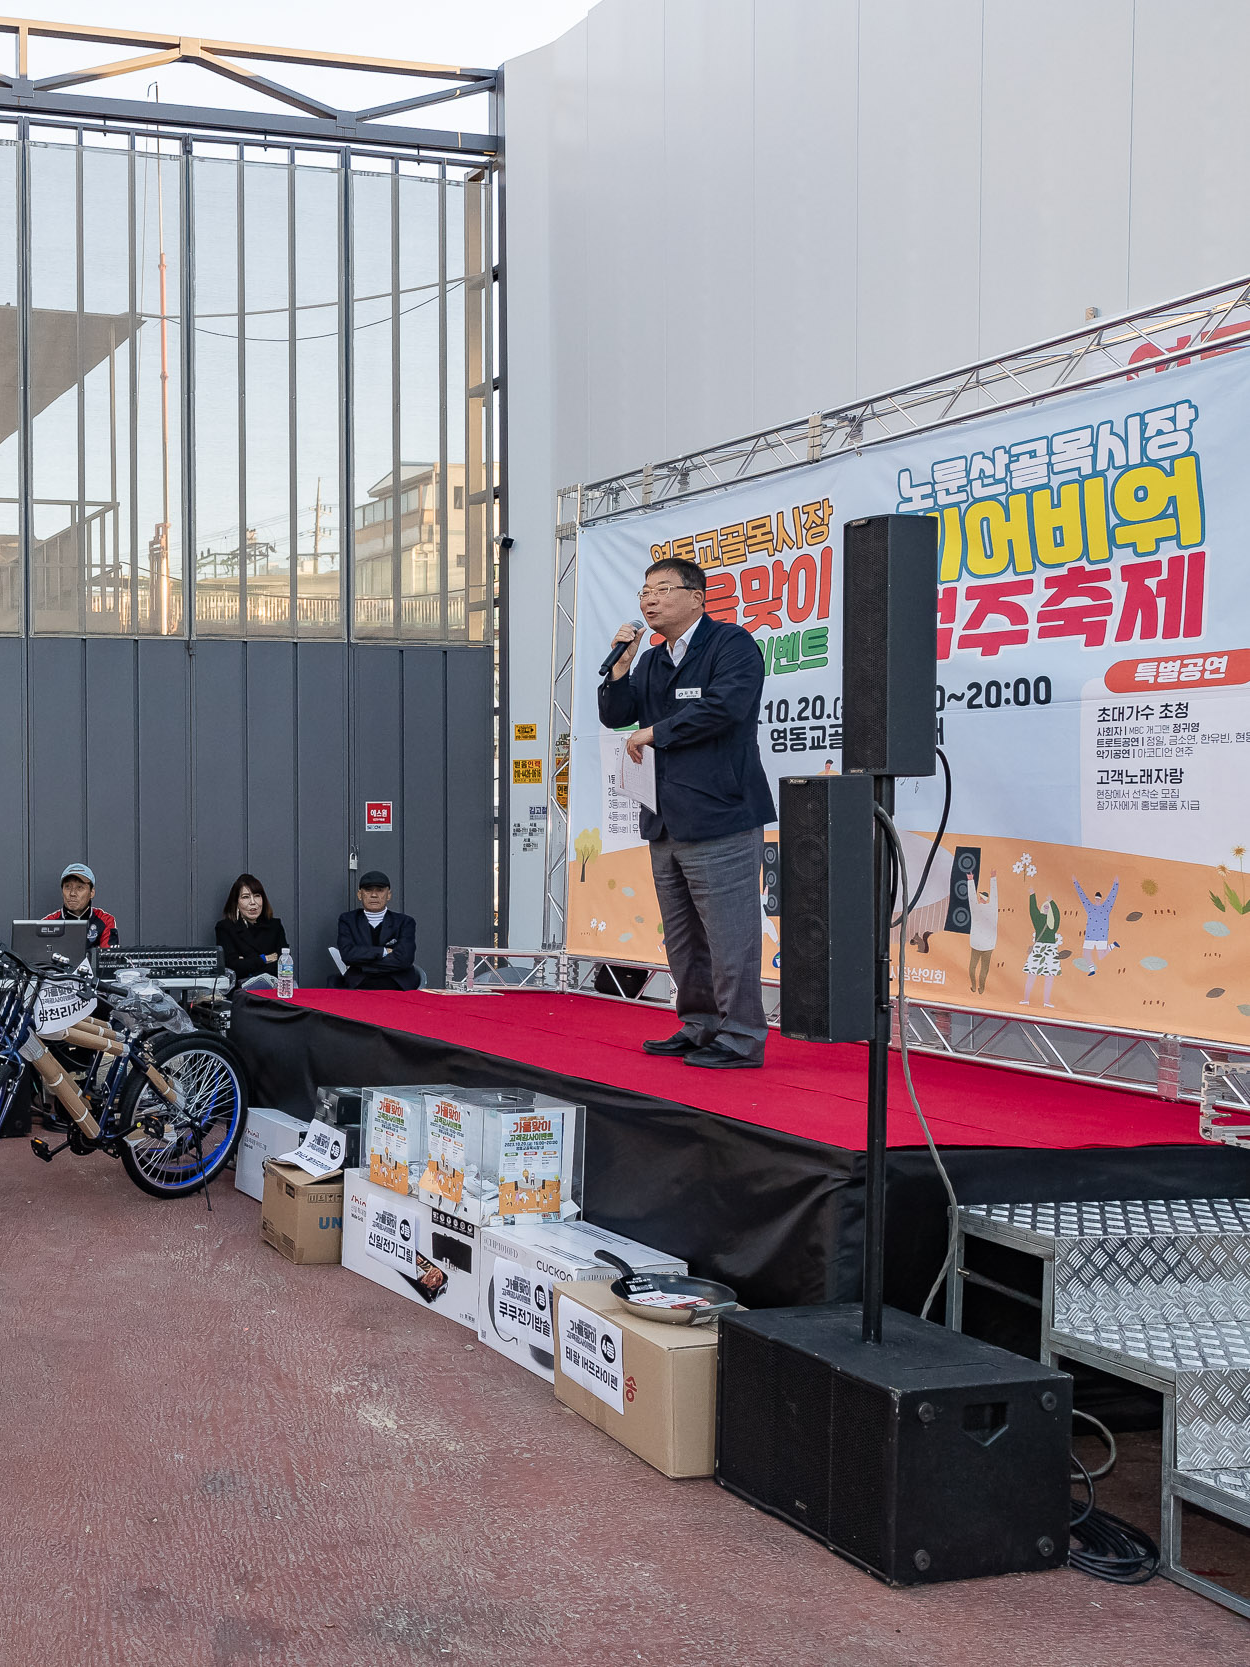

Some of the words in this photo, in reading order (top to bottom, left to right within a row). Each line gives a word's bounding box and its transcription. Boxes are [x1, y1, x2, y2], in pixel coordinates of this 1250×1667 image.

[896, 399, 1199, 514] 노룬산골목시장
[1134, 655, 1229, 684] 특별공연
[1096, 705, 1155, 723] 초대가수
[1158, 702, 1190, 720] 초청
[1096, 725, 1123, 737] 사회자
[1128, 725, 1144, 735] MBC
[1146, 724, 1170, 735] 개그맨
[1096, 737, 1139, 748] 트로트공연
[1096, 749, 1130, 760] 악기공연
[1137, 747, 1173, 759] 아코디언
[1096, 767, 1184, 786] 고객노래자랑
[1096, 789, 1130, 800] 현장에서
[1131, 788, 1159, 799] 선착순
[1160, 788, 1180, 799] 모집
[1180, 800, 1200, 811] 지급
[513, 1120, 551, 1133] 가을맞이
[400, 1223, 411, 1238] 3등
[368, 1231, 414, 1265] 신일전기그릴
[535, 1289, 546, 1307] 1등
[498, 1300, 551, 1338] 쿠쿠전기밥솥
[565, 1345, 580, 1367] 테팔
[601, 1338, 616, 1360] 4등
